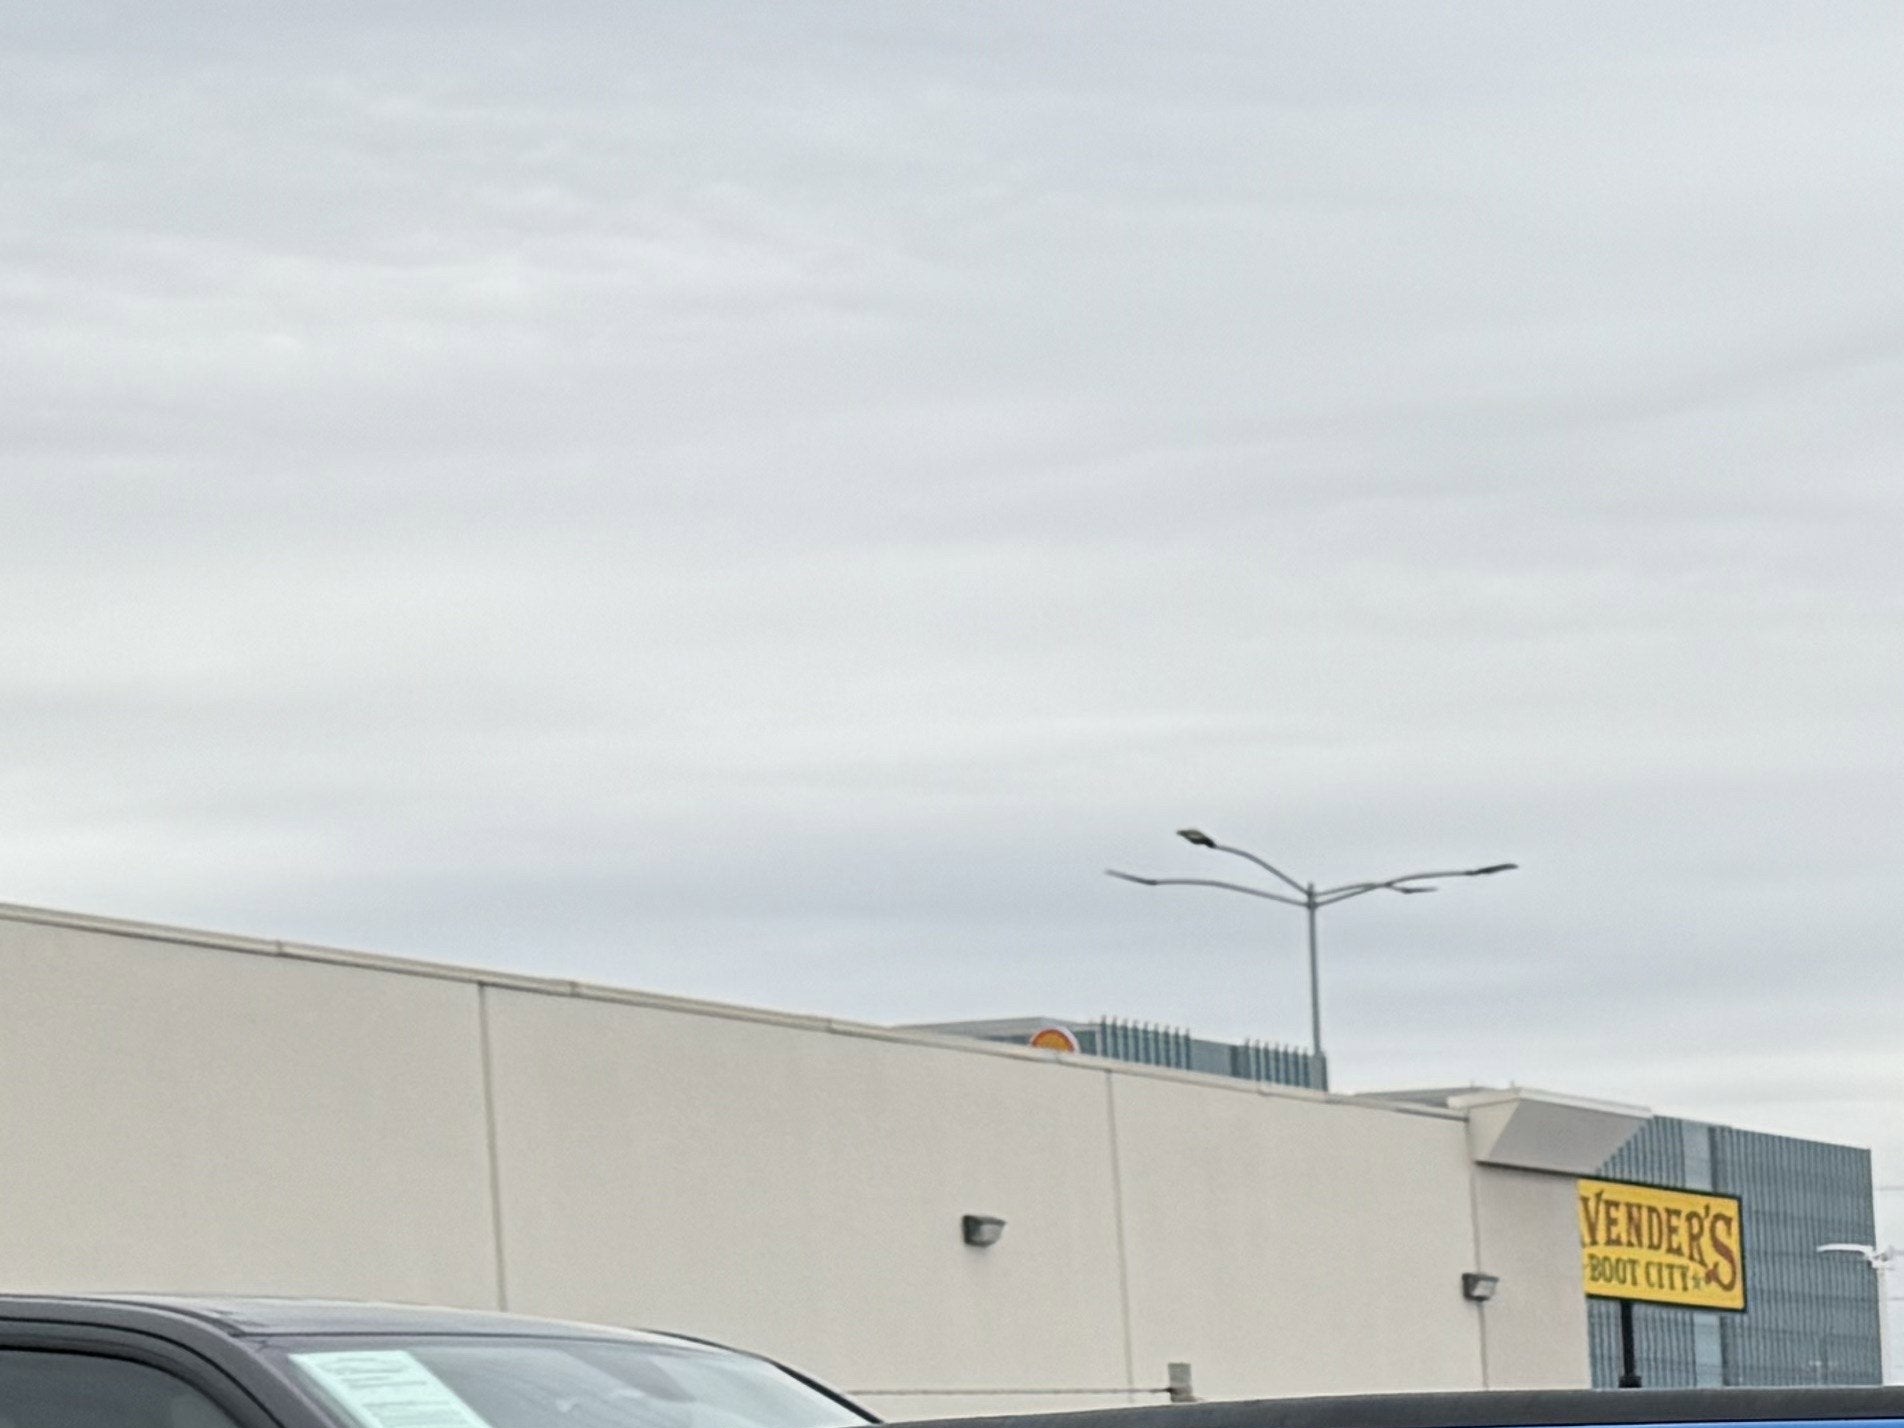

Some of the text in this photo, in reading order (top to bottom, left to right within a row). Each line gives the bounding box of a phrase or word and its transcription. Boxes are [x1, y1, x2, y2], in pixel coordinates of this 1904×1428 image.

[1580, 1189, 1738, 1292] VENDER'S
[1587, 1253, 1690, 1292] BOOT CITY
